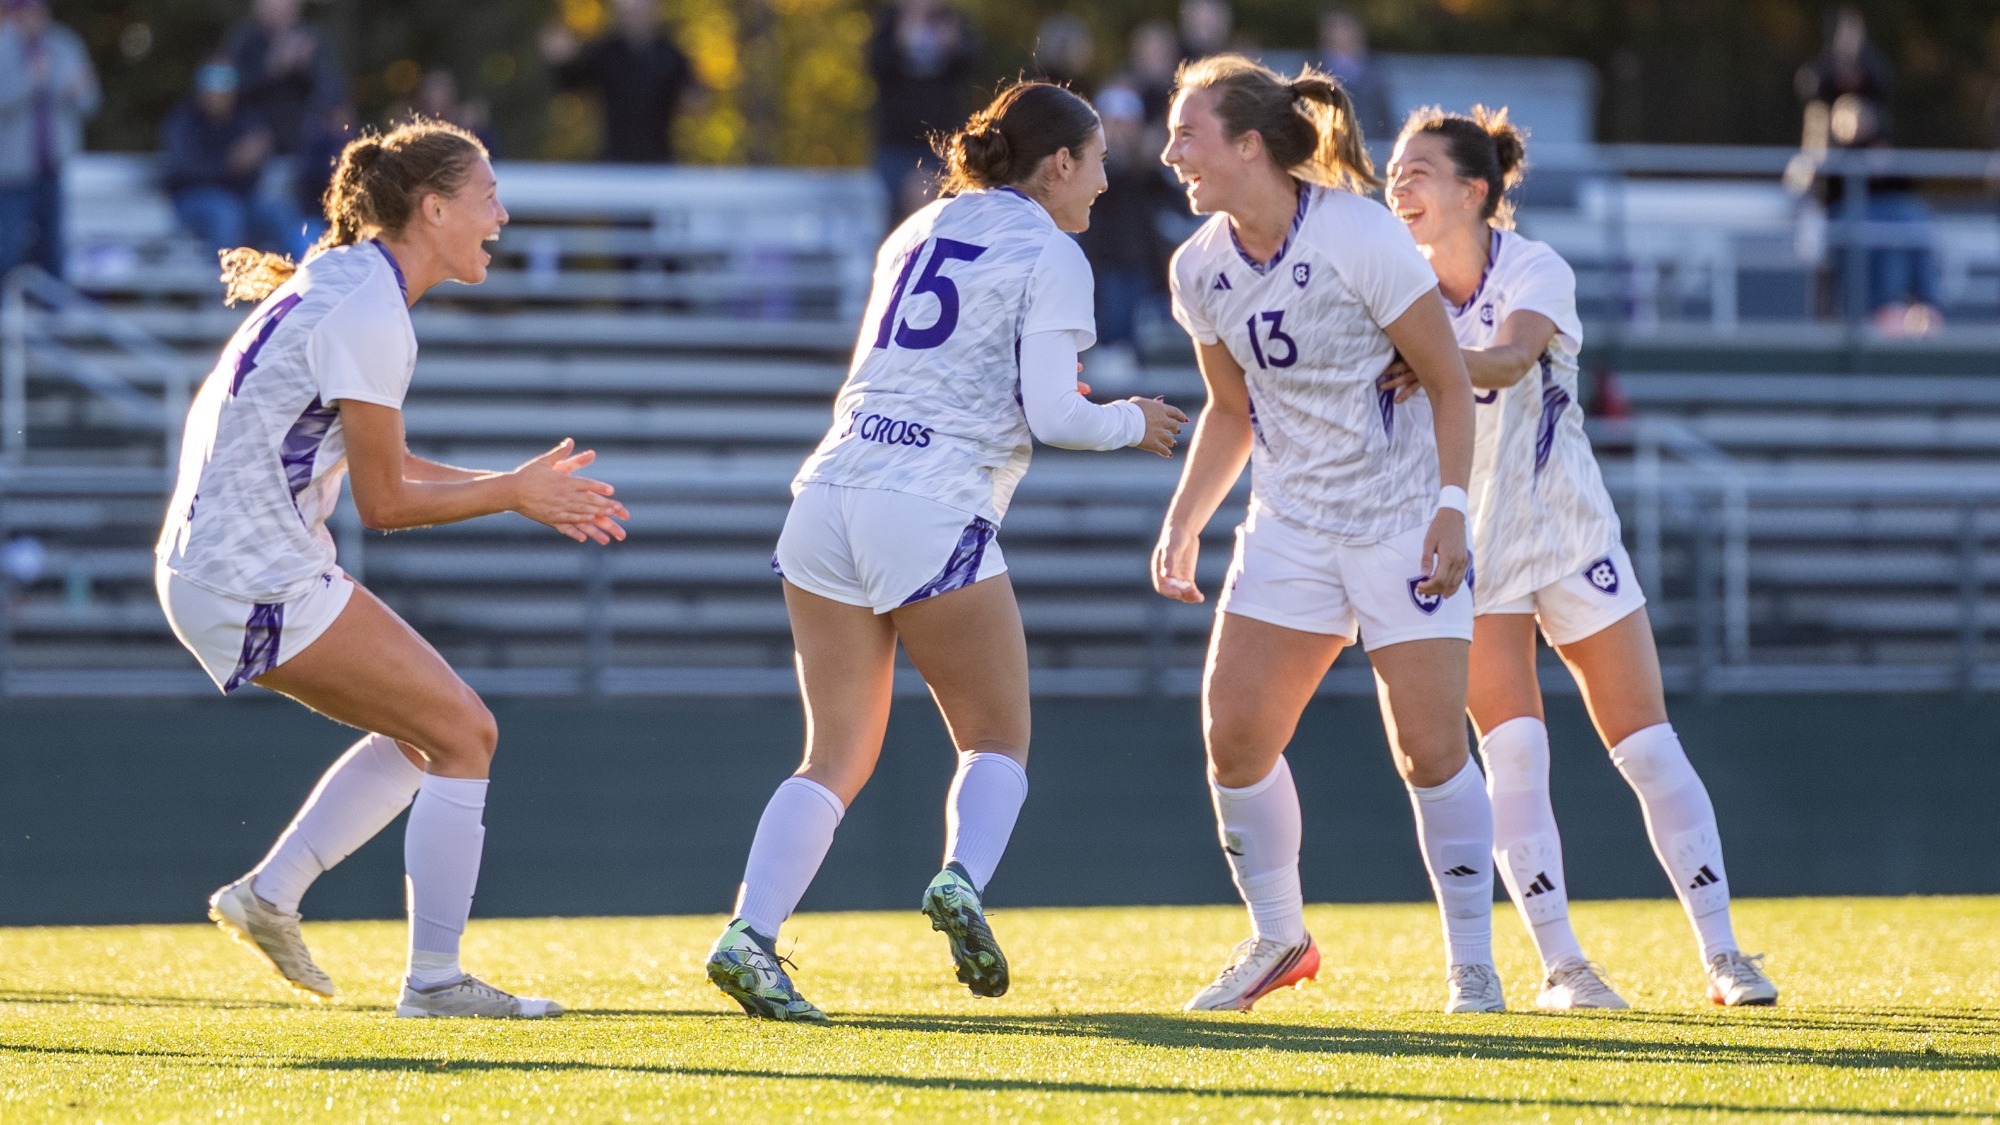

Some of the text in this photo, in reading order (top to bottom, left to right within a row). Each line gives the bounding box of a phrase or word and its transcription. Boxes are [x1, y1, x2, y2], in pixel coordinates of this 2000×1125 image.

[874, 237, 988, 350] 15
[1246, 310, 1298, 369] 13
[861, 414, 935, 448] CROSS
